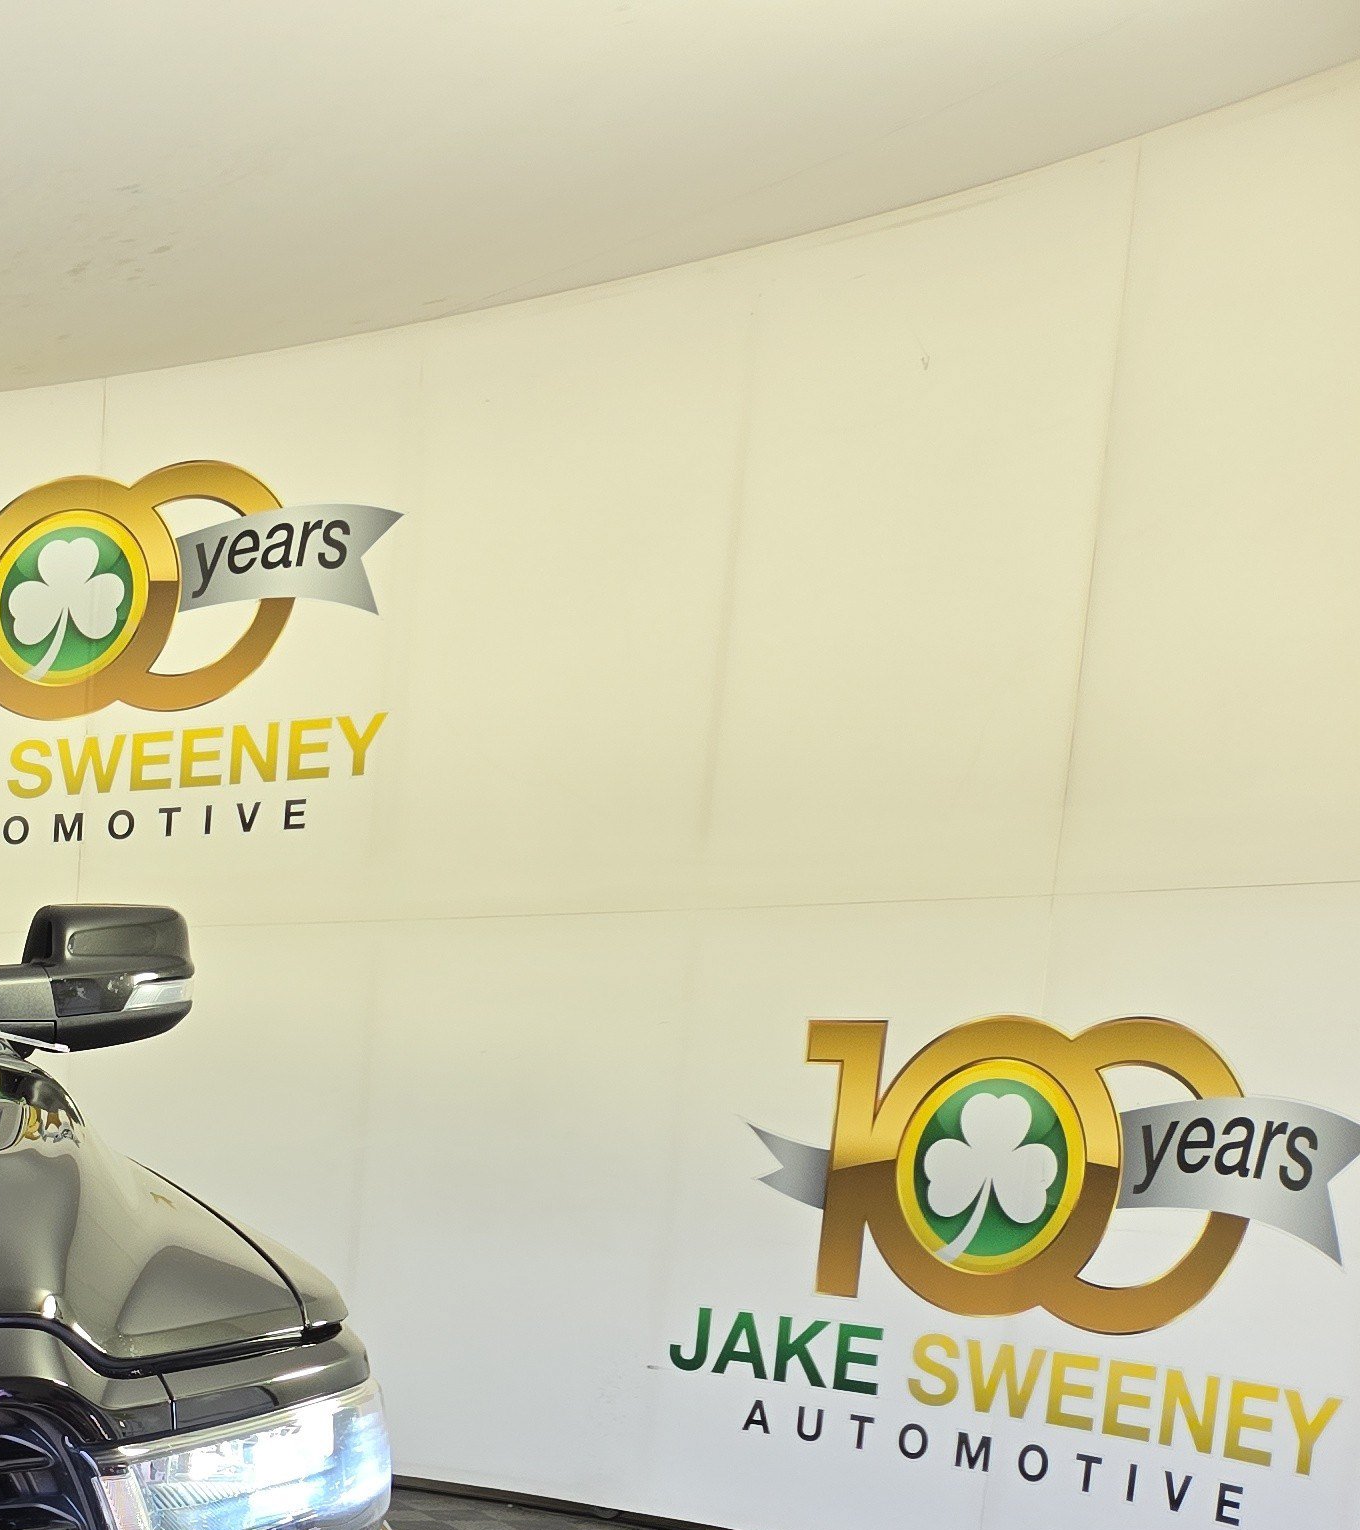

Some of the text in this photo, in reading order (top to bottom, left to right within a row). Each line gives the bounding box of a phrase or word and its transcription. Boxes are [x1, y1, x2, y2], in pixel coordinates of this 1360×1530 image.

[191, 516, 351, 599] years
[6, 711, 389, 799] SWEENEY
[805, 1015, 1318, 1336] 100 years
[669, 1307, 1343, 1478] JAKE SWEENEY
[742, 1399, 1245, 1527] AUTOMOTIVE
